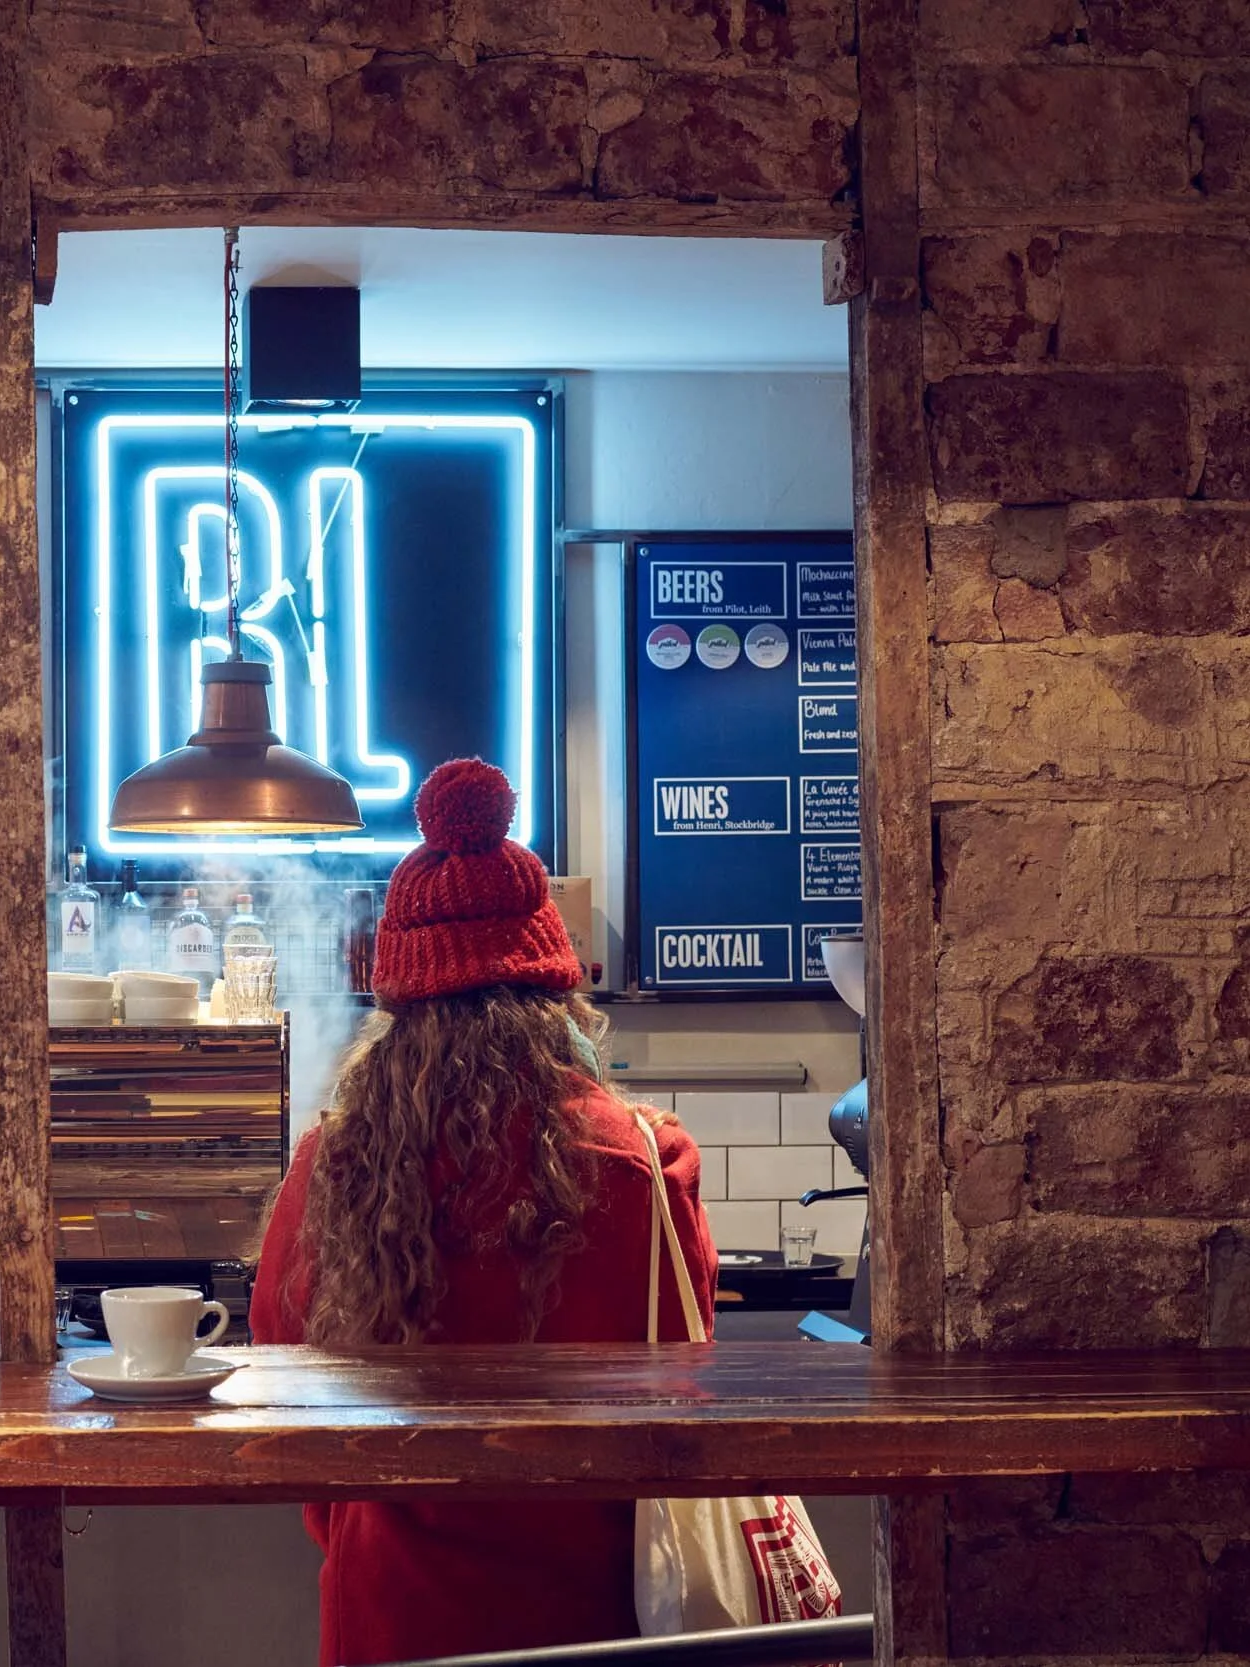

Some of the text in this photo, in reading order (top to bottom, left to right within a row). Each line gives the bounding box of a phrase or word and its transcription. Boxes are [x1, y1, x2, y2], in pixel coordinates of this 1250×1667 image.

[657, 570, 724, 604] BEERS
[702, 604, 771, 615] from Pilot, Leith
[660, 786, 729, 820] WINES
[673, 820, 775, 832] from Henri, Stockbridge
[662, 933, 764, 968] COCKTAIL
